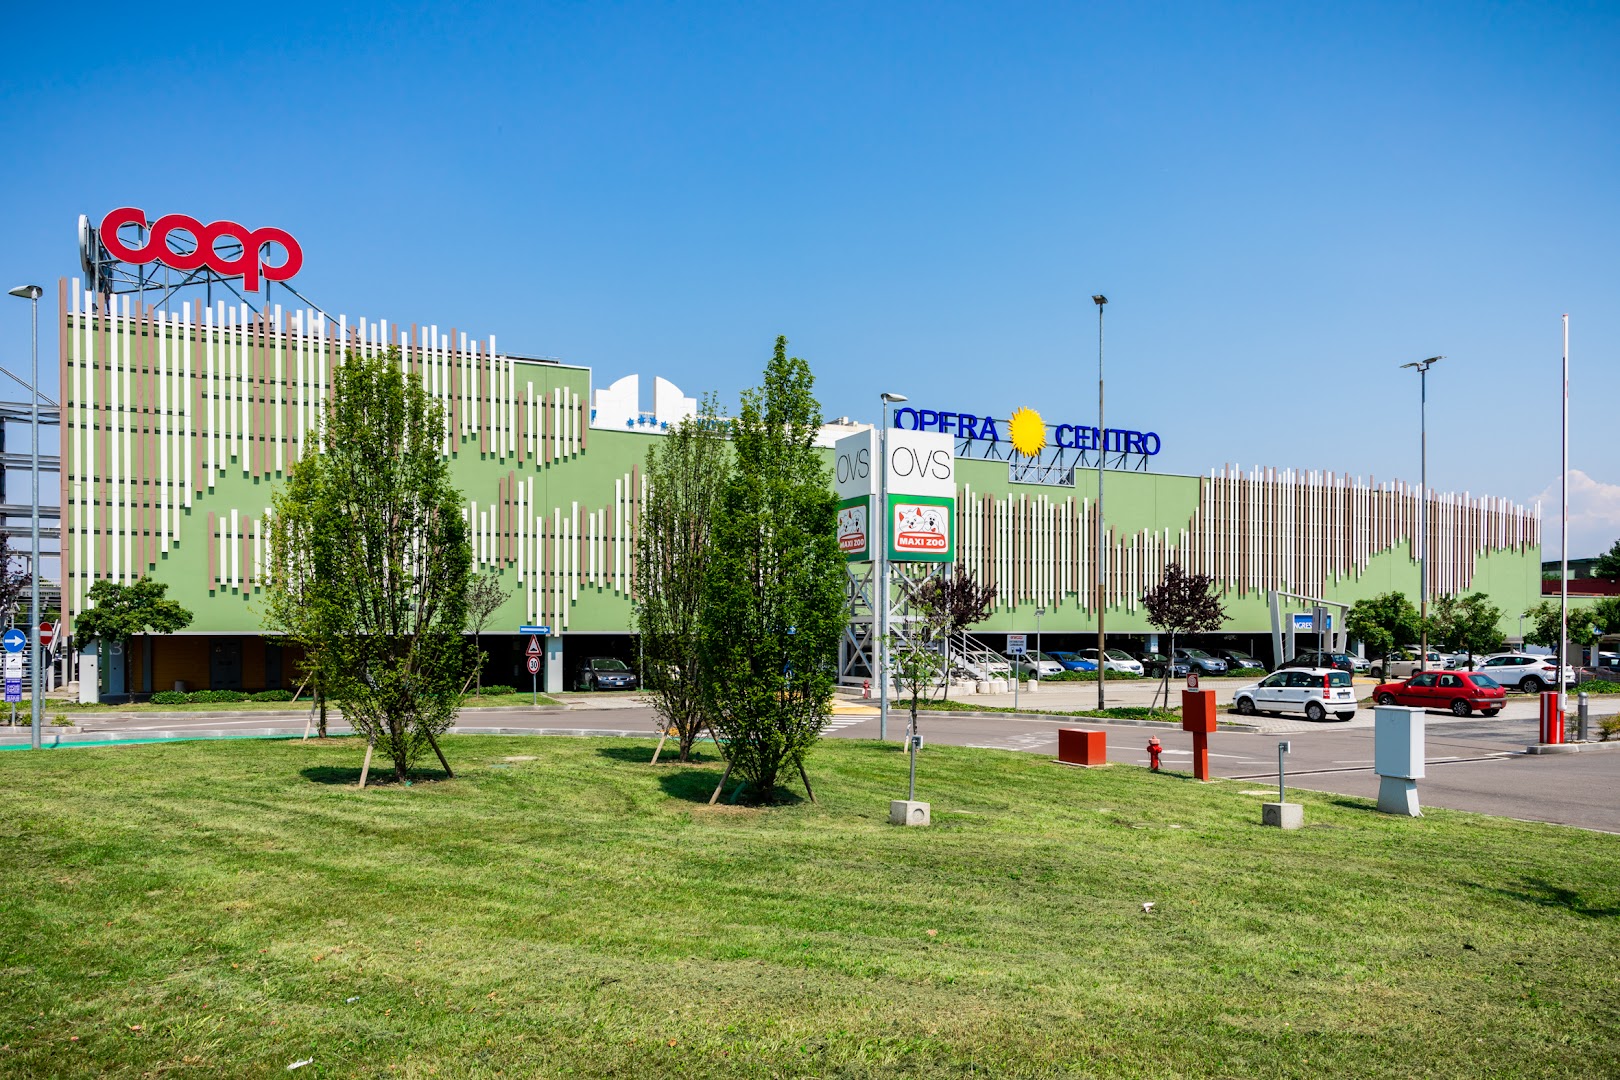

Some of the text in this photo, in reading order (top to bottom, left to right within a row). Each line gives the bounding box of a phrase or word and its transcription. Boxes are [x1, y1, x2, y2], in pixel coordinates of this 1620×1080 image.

[100, 207, 303, 293] coop
[896, 407, 1161, 456] OPERA CENTRO
[836, 448, 870, 484] OVS
[892, 446, 951, 480] OVS
[854, 538, 865, 547] ZOO
